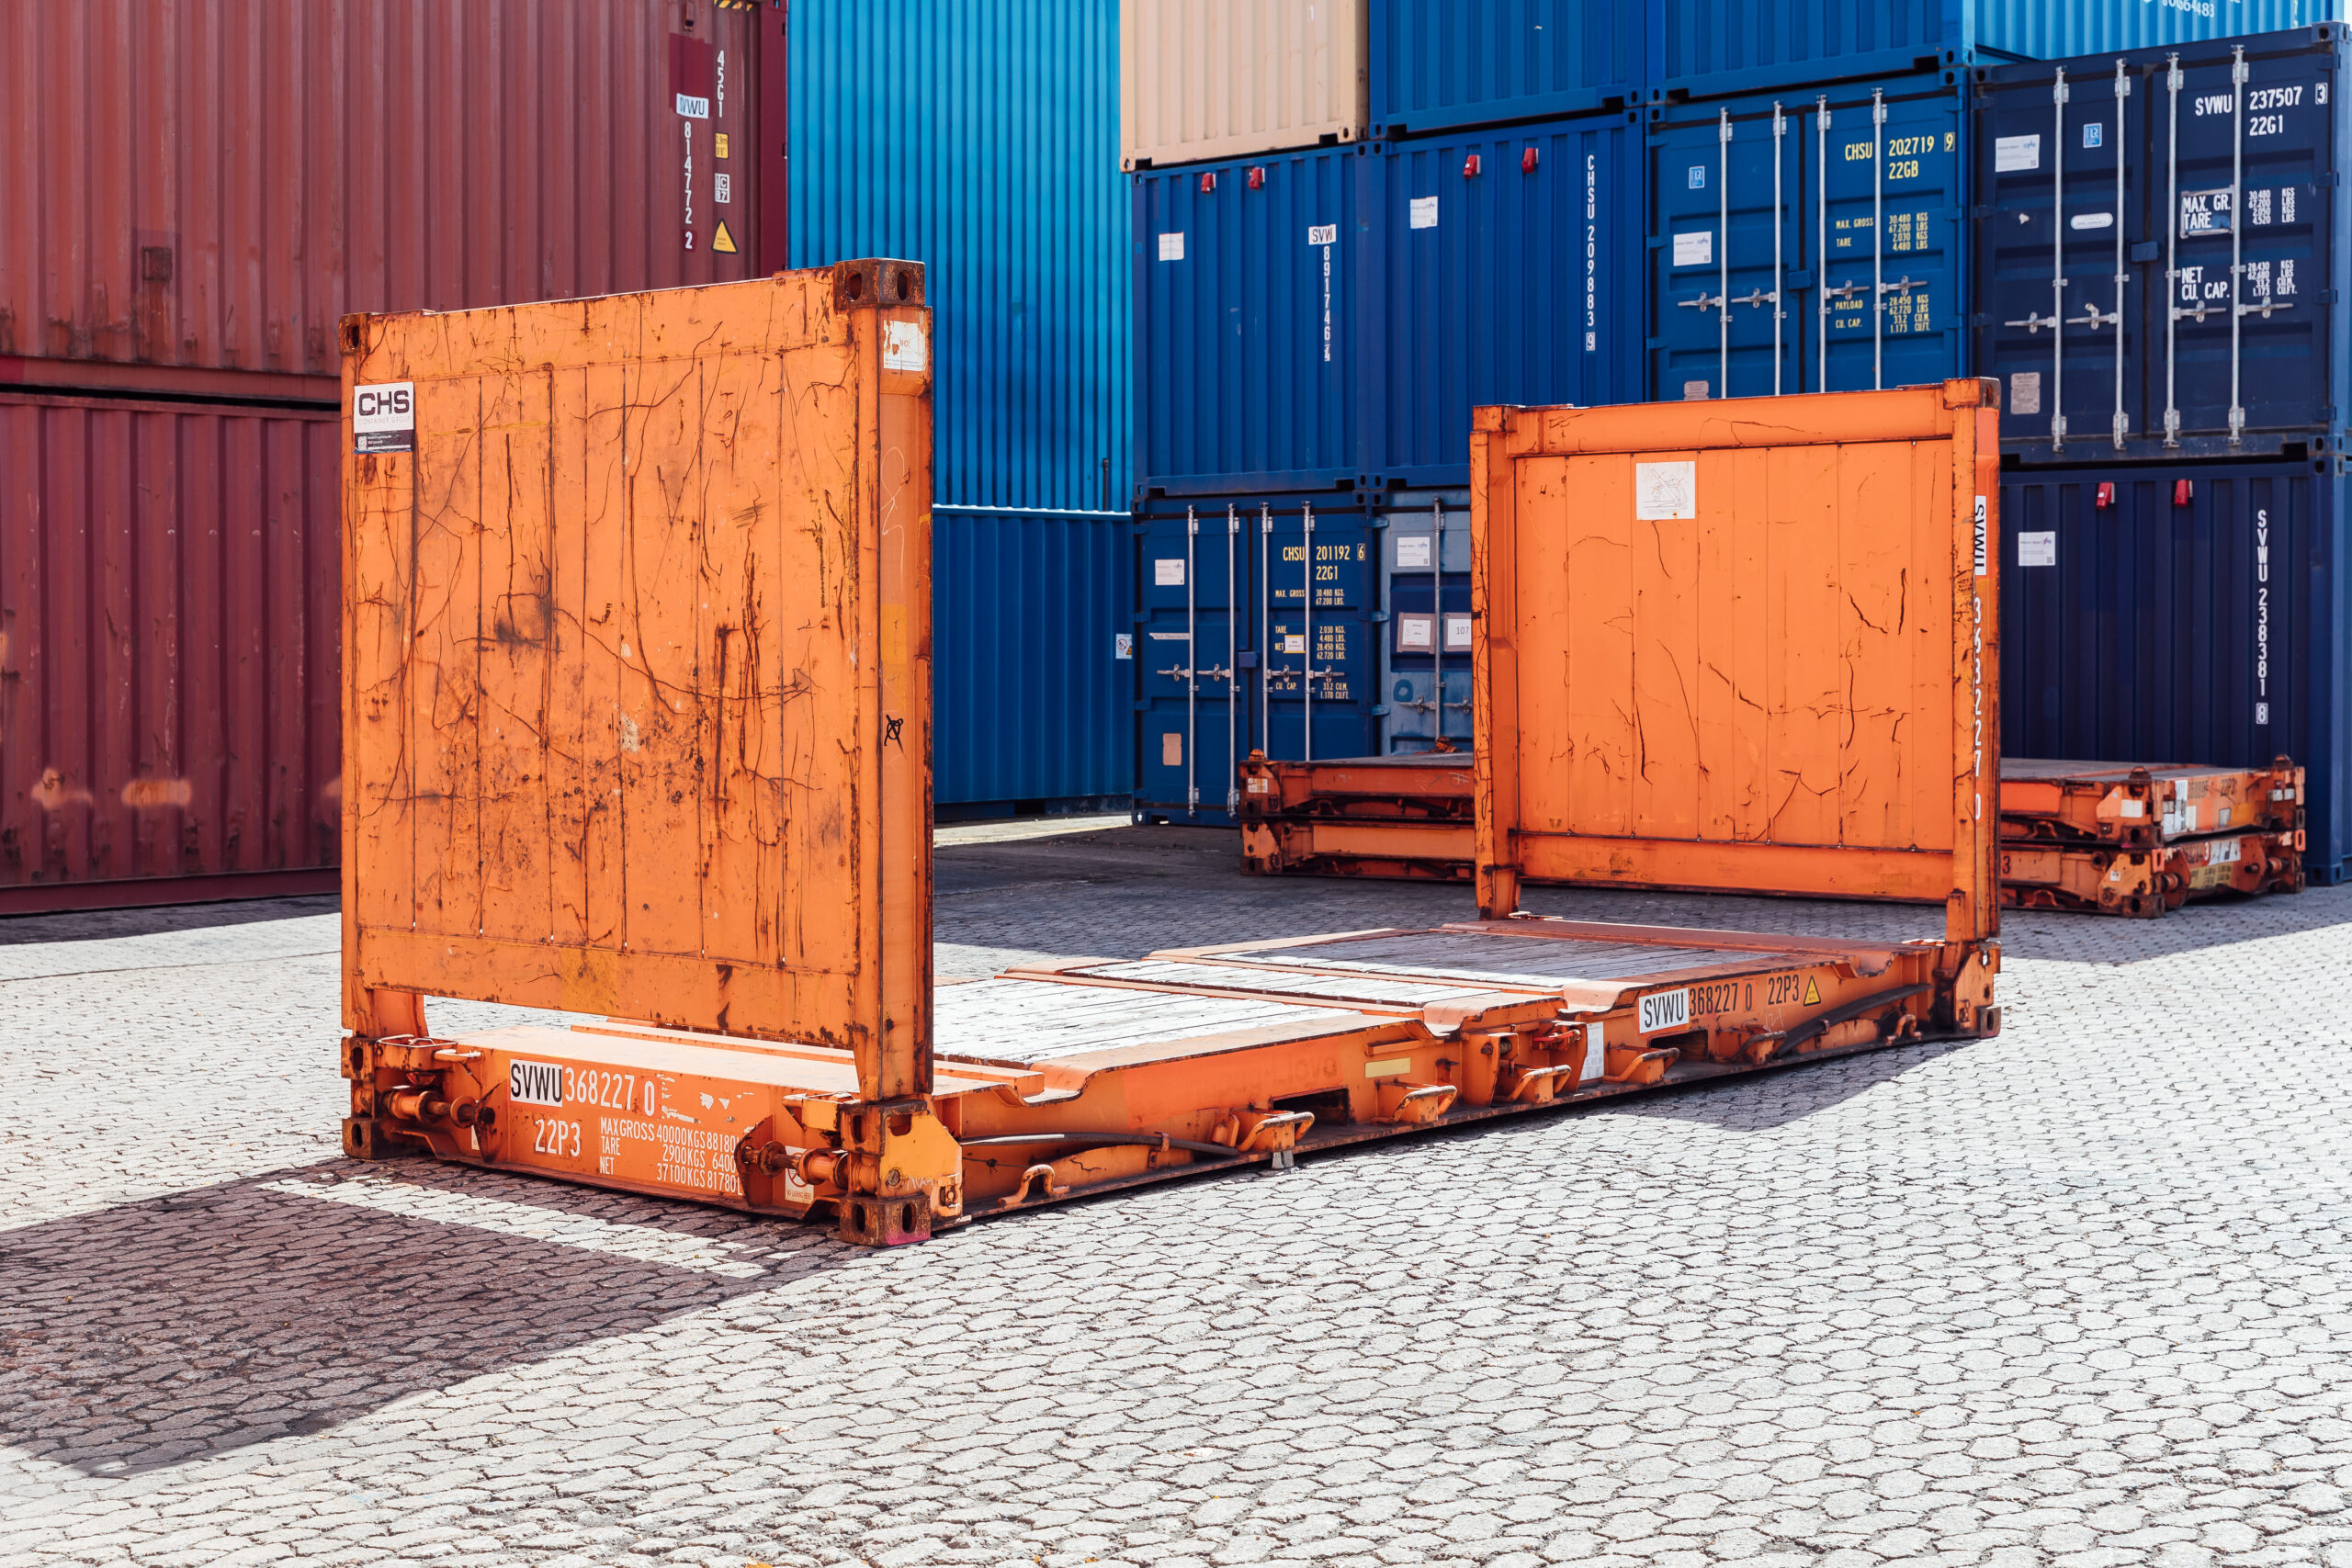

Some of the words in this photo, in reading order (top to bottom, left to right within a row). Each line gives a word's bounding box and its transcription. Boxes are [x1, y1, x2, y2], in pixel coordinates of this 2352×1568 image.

[717, 50, 725, 118] 45G1
[679, 96, 706, 116] SVWU
[2194, 94, 2233, 117] SVWU
[2249, 85, 2303, 110] 237507
[2316, 85, 2326, 105] 3
[2249, 114, 2284, 137] 22G1
[1844, 141, 1873, 162] CHSU
[1888, 135, 1935, 157] 202719
[1945, 132, 1954, 151] 9
[684, 121, 693, 224] 814772
[1888, 160, 1919, 180] 22GB
[1587, 154, 1595, 220] CHSU
[2182, 195, 2209, 214] MAX.
[2212, 194, 2232, 211] GR.
[2281, 186, 2295, 197] KGS
[2281, 197, 2295, 207] LBS
[1853, 217, 1874, 229] GROSS
[1916, 211, 1928, 221] KGS
[1916, 220, 1928, 231] LBS
[2183, 211, 2212, 231] TARE
[2281, 206, 2295, 215] KGS
[2281, 214, 2295, 223] LBS
[684, 231, 693, 249] 2
[1836, 236, 1852, 248] TARE
[1916, 231, 1928, 241] KGS
[1916, 240, 1928, 251] LBS
[1587, 225, 1595, 327] 209883
[2181, 265, 2204, 284] NET
[2280, 259, 2294, 269] KGS
[2280, 268, 2294, 278] LBS
[1323, 245, 1331, 341] 891746
[2181, 283, 2199, 300] CU.
[2204, 281, 2231, 299] CAP.
[1835, 299, 1864, 310] PAYLOAD
[1917, 294, 1929, 304] KGS
[1917, 303, 1929, 313] LBS
[1848, 317, 1862, 328] CAP.
[1587, 333, 1595, 351] 9
[358, 389, 410, 416] CHS
[1283, 546, 1305, 561] CHSU
[1316, 545, 1351, 560] 201192
[1358, 545, 1364, 559] 6
[2256, 509, 2268, 582] SVWU
[1316, 565, 1338, 581] 22G1
[1275, 590, 1287, 598] MAX.
[1289, 590, 1305, 598] GROSS
[1275, 626, 1287, 634] TARE
[1456, 626, 1470, 635] 107
[1274, 642, 1284, 651] NET
[2257, 588, 2268, 696] 238381
[1286, 682, 1297, 690] CAP.
[2257, 704, 2267, 723] 8
[1644, 991, 1684, 1028] SVWU
[1689, 982, 1738, 1016] 368227
[1746, 983, 1752, 1010] 0
[1768, 974, 1800, 1006] 22P3
[511, 1063, 562, 1102] SVWU
[564, 1066, 635, 1111] 368227
[644, 1080, 655, 1116] 0
[535, 1118, 581, 1157] 22P3
[600, 1116, 619, 1136] MAX
[619, 1119, 655, 1142] GROSS
[656, 1123, 687, 1146] 40000
[688, 1129, 706, 1149] KGS
[707, 1132, 736, 1153] 88180
[601, 1135, 621, 1156] TARE
[662, 1144, 687, 1165] 2900
[688, 1148, 706, 1168] KGS
[712, 1152, 736, 1174] 6400
[599, 1156, 615, 1175] NET
[656, 1163, 687, 1184] 37100
[688, 1168, 706, 1188] KGS
[707, 1170, 736, 1193] 81780
